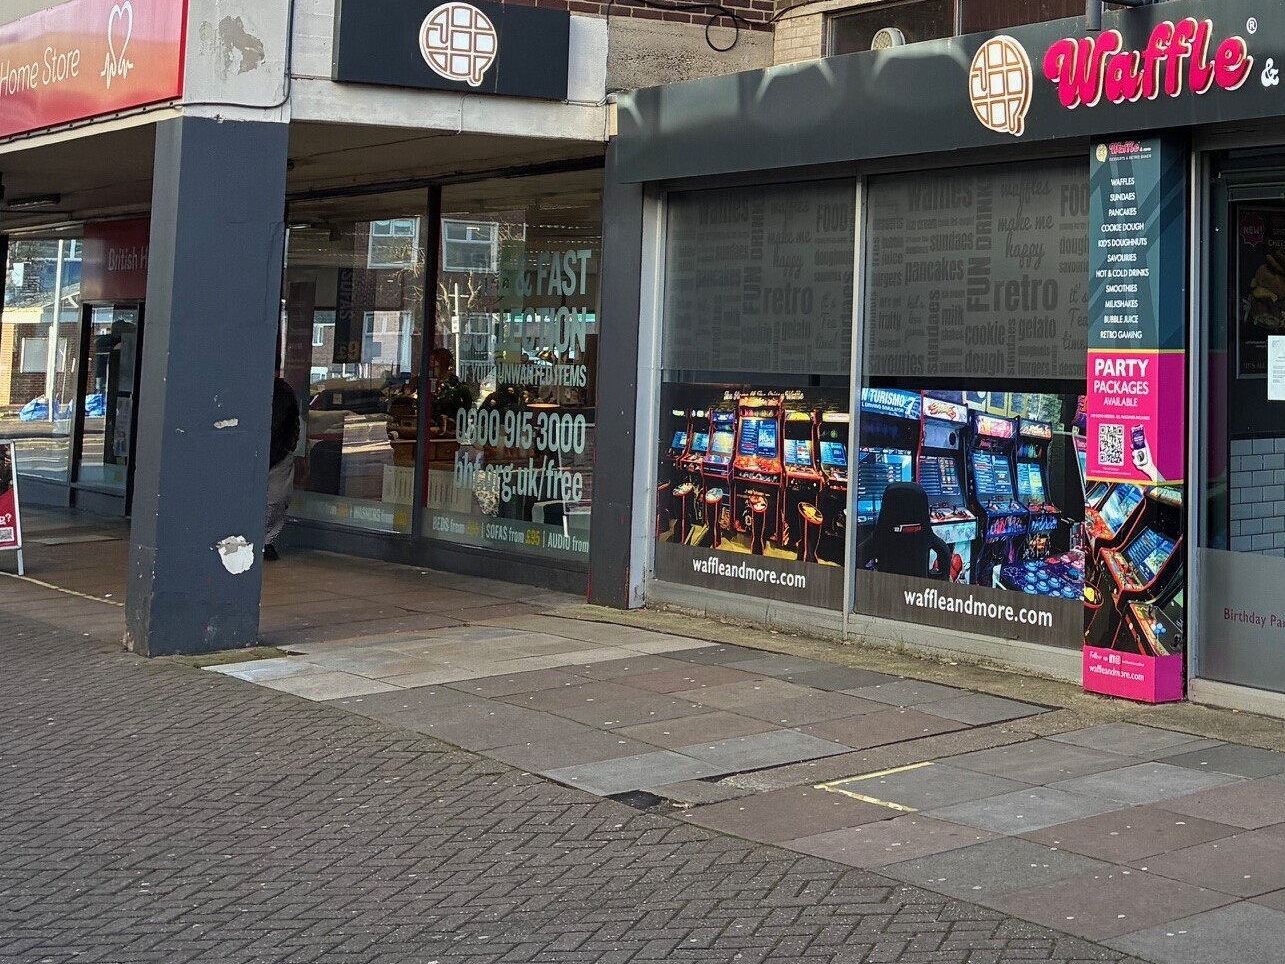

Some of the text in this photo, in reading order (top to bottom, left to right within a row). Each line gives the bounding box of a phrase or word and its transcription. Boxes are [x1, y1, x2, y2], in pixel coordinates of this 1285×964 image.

[0, 46, 81, 97] Home Store
[1043, 16, 1255, 109] Waffle
[1261, 57, 1279, 87] &
[1110, 177, 1135, 186] WAFFLES
[1060, 182, 1090, 217] FOO
[1109, 192, 1136, 201] SUNDAES
[816, 202, 848, 233] FOOD
[998, 203, 1032, 233] make
[1035, 215, 1055, 230] me
[1108, 207, 1137, 216] PANCAKES
[1101, 222, 1145, 232] COOKIE DOUGH
[929, 231, 973, 252] sundaes
[1005, 230, 1047, 271] happy
[1111, 237, 1148, 247] DOUGHNUTS
[107, 245, 138, 272] British
[1059, 258, 1089, 274] savourie
[1107, 253, 1137, 262] SAVOURIES
[536, 248, 592, 297] FAST
[904, 256, 964, 286] pancakes
[966, 256, 992, 312] FUN
[1095, 269, 1107, 278] HOT
[1112, 269, 1127, 277] COLD
[1128, 268, 1150, 277] DRINKS
[742, 266, 762, 315] FUN
[763, 281, 813, 315] retro
[992, 273, 1060, 312] retro
[1105, 284, 1138, 293] SMOOTHIES
[1105, 299, 1139, 308] MILKSHAKES
[1018, 316, 1057, 342] gelato
[1104, 314, 1139, 323] BUBBLE JUICE
[927, 289, 940, 375] sundaes
[965, 320, 1006, 346] cookie
[1062, 330, 1088, 350] time
[1100, 330, 1143, 339] RETRO GAMING
[869, 350, 925, 375] savouries
[964, 348, 1005, 376] dough
[1094, 358, 1149, 377] PARTY
[870, 388, 905, 408] TURISMO
[1093, 380, 1150, 395] PACKAGES
[1103, 397, 1138, 407] AVAILABLE
[456, 407, 586, 454] 0800 915 3000
[454, 450, 583, 503] bhf.org.uk/free
[486, 523, 508, 541] SOFAS
[508, 527, 525, 544] from
[547, 532, 571, 552] AUDIO
[572, 537, 589, 554] from
[692, 556, 806, 588] waffleandmore.com
[904, 588, 1053, 628] waffleandmore.com
[1223, 607, 1267, 629] Birthday
